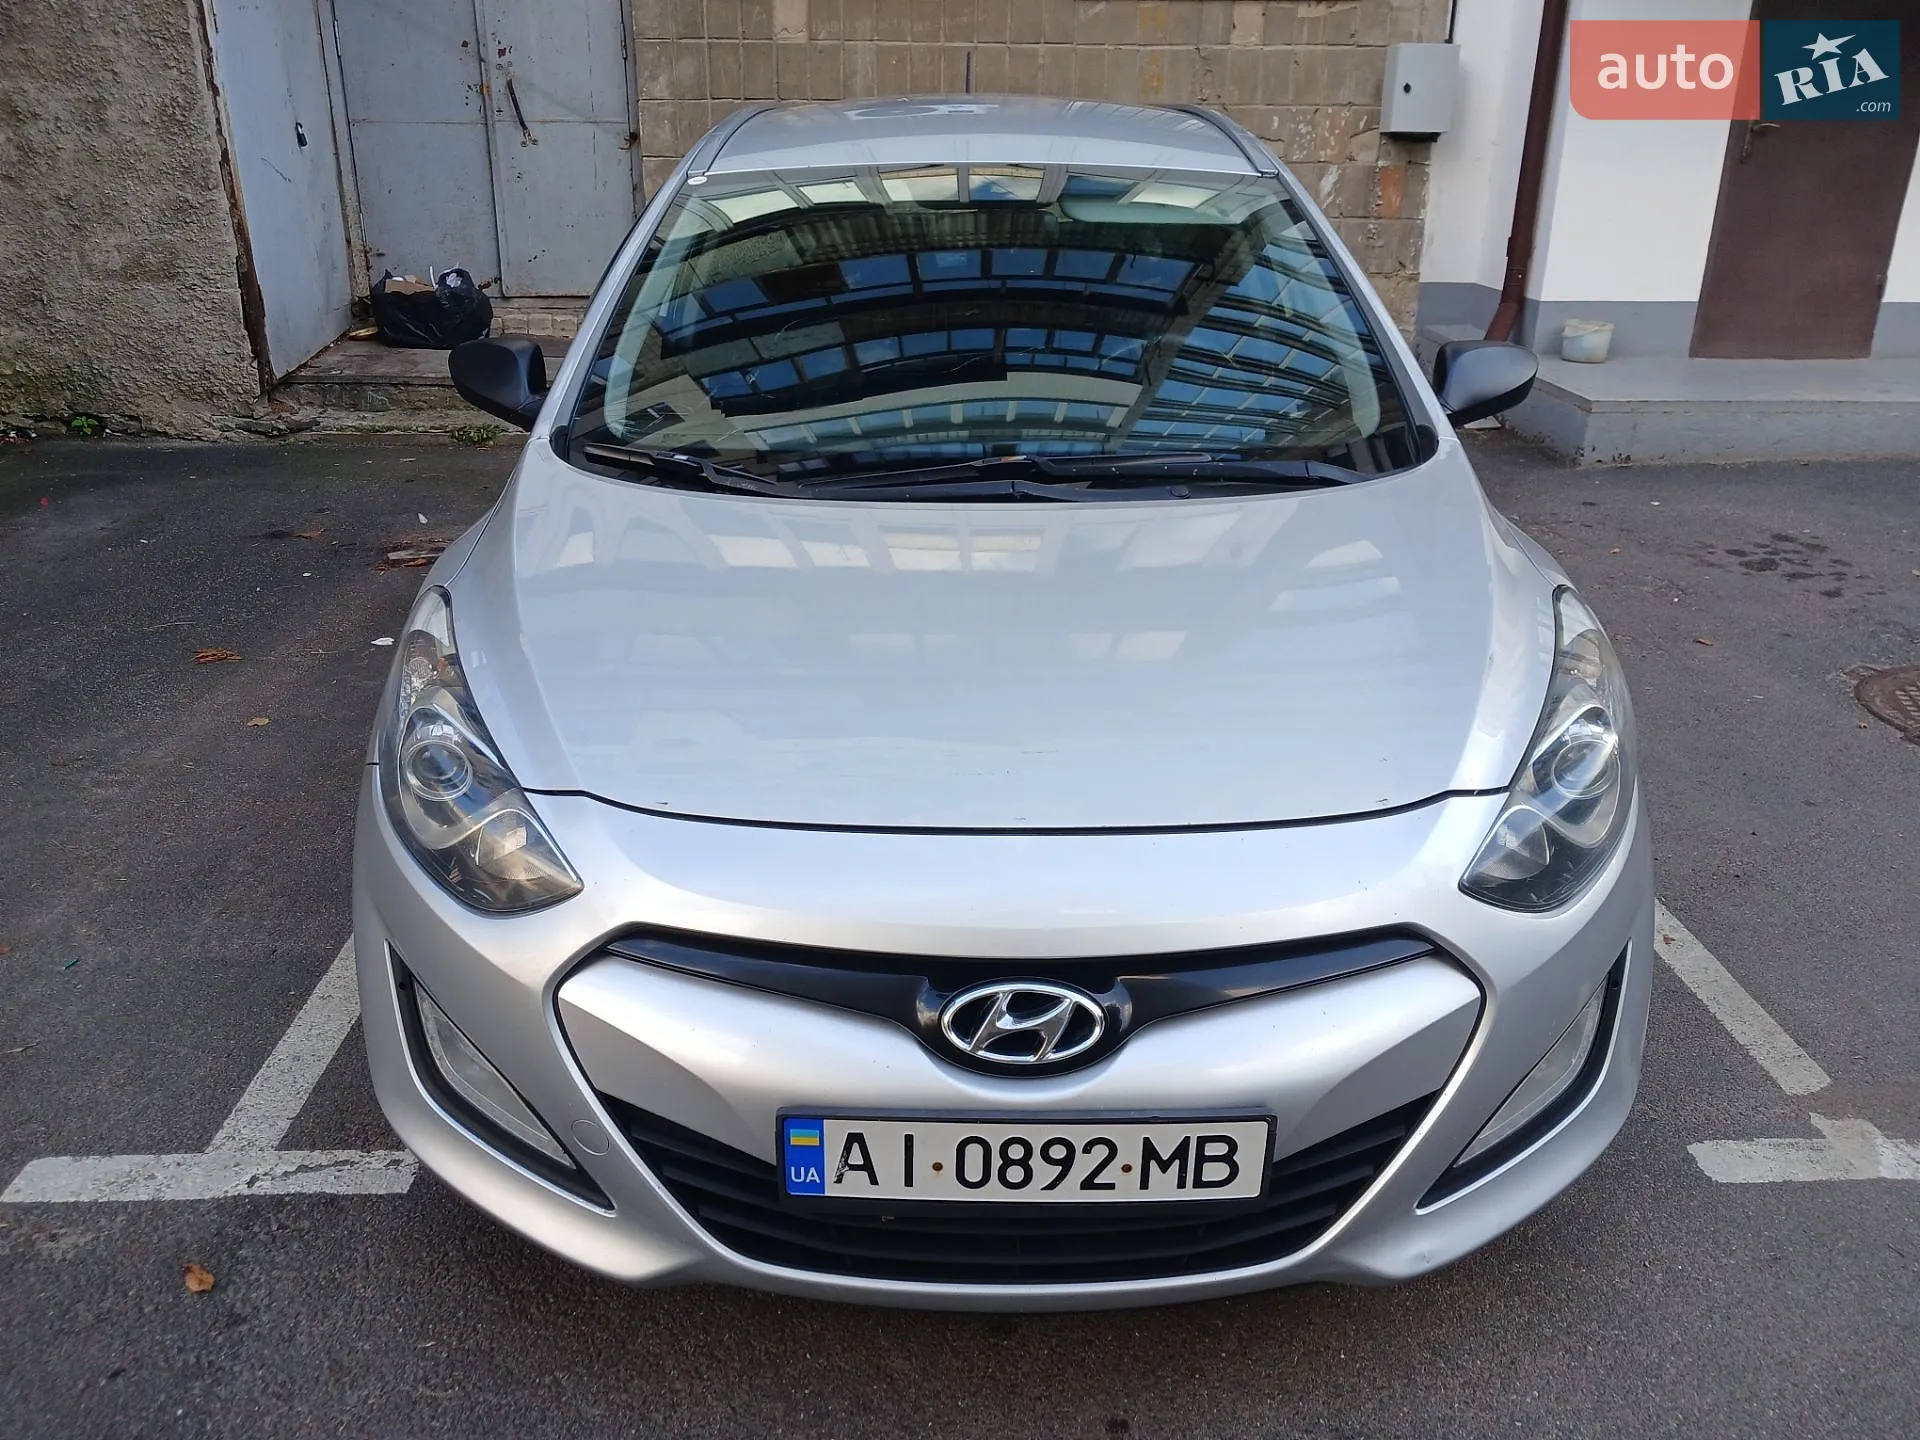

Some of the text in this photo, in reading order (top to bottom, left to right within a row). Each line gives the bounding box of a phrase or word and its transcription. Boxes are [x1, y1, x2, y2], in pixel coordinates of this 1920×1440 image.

[791, 1166, 820, 1184] UA
[833, 1131, 1240, 1191] AI 0892 MB
